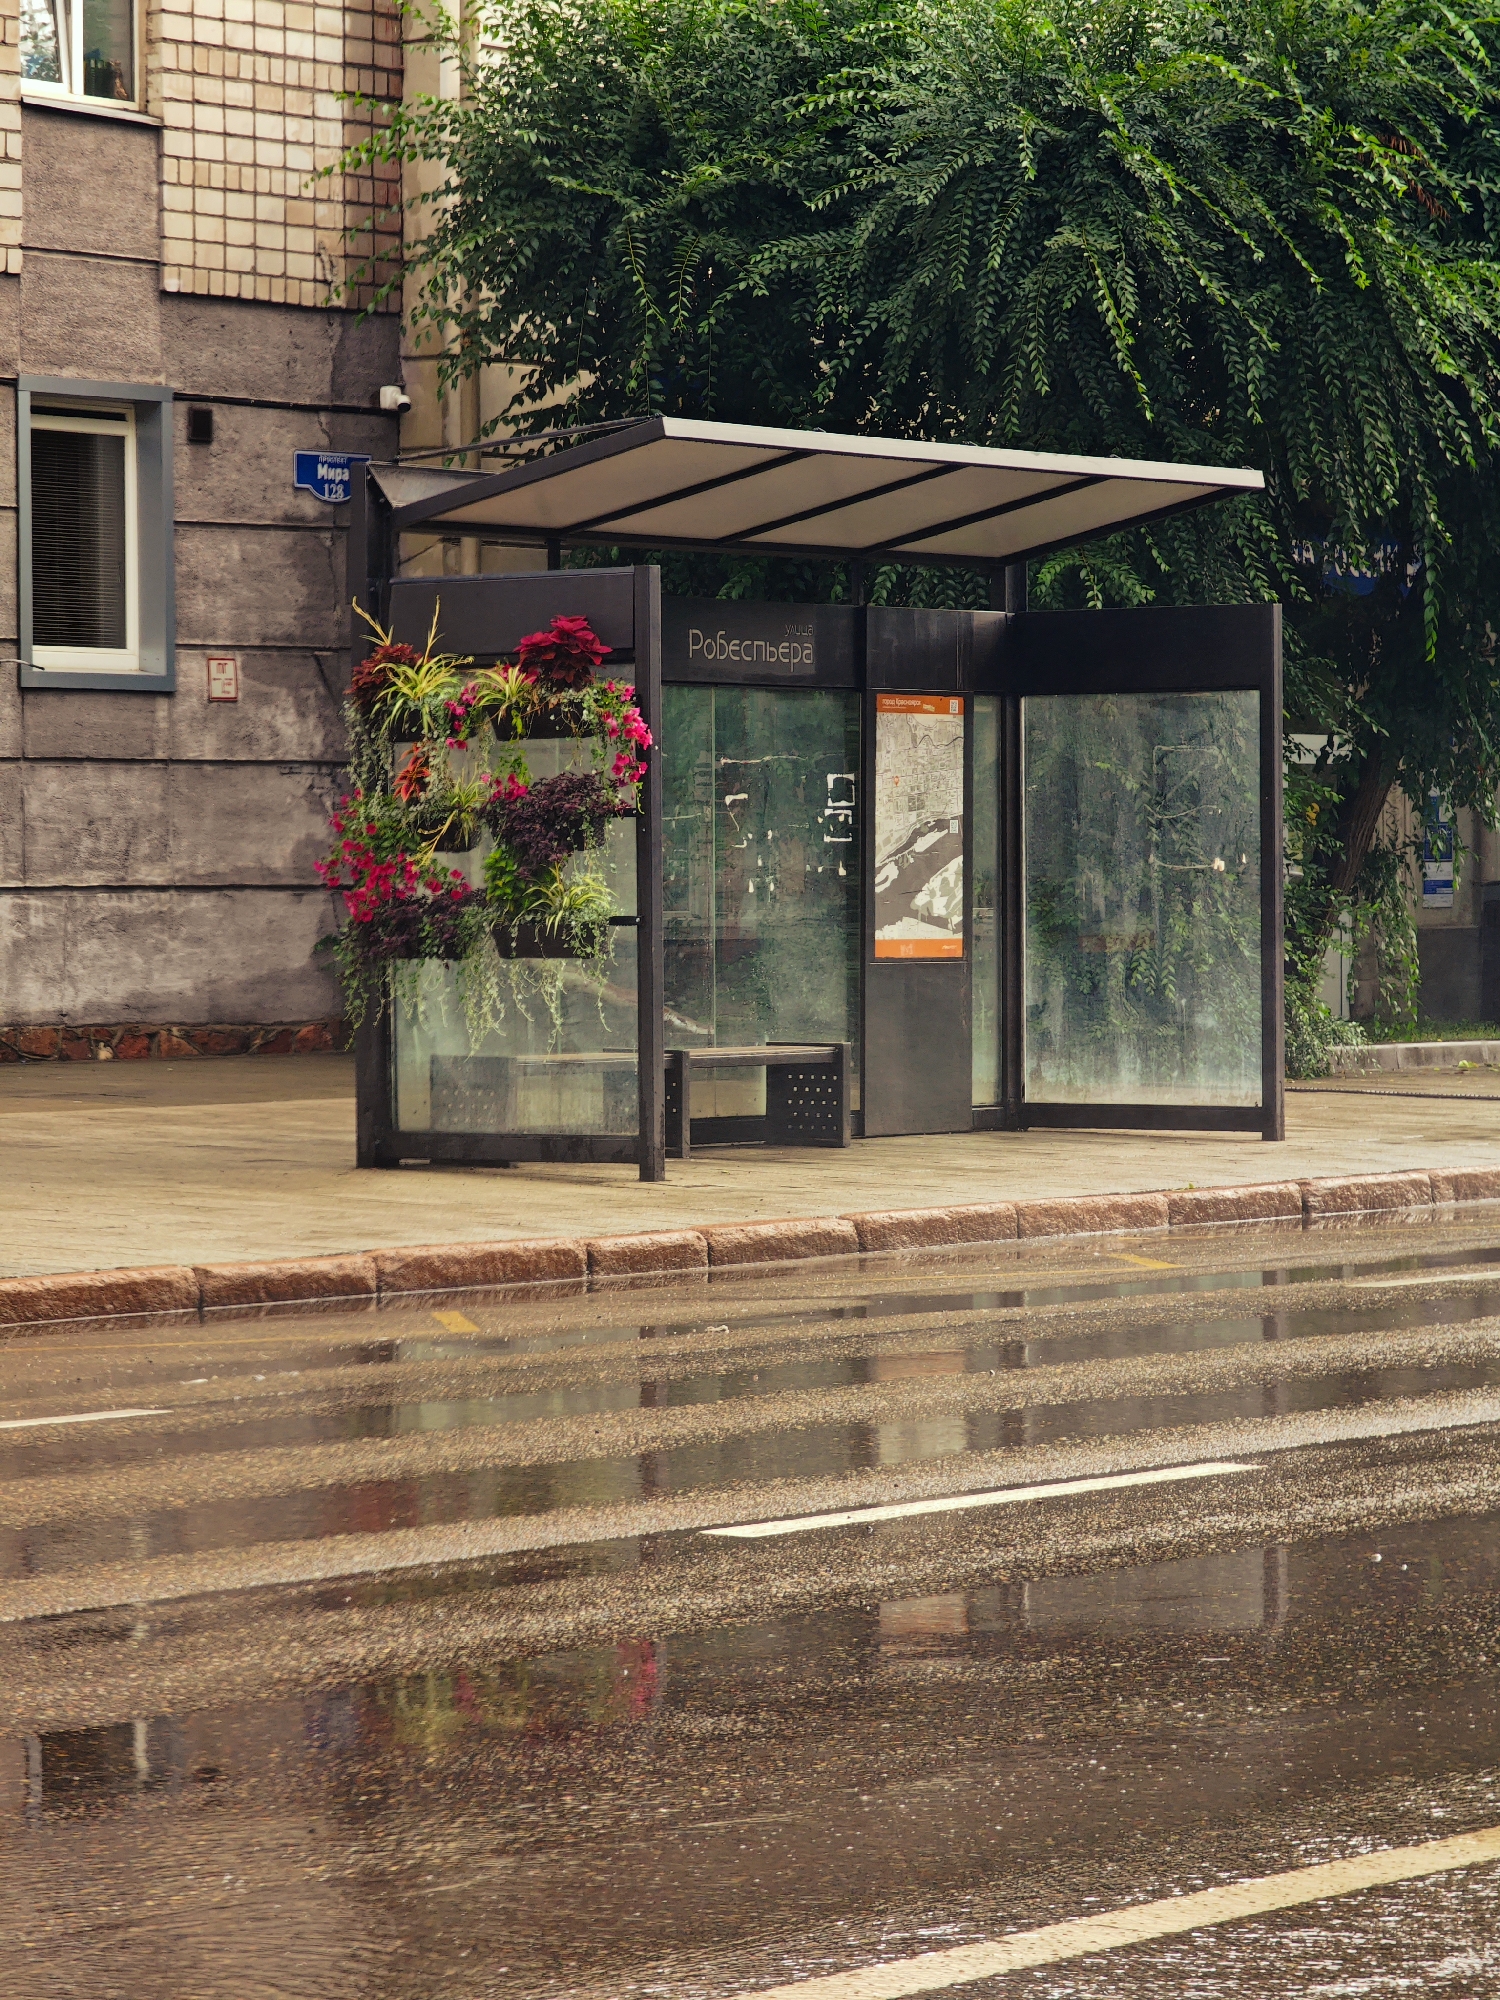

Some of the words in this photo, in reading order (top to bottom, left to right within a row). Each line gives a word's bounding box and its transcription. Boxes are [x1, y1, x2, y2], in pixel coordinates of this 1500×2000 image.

[317, 463, 350, 483] Мира
[323, 483, 344, 499] 128
[688, 628, 814, 673] Робеспьера
